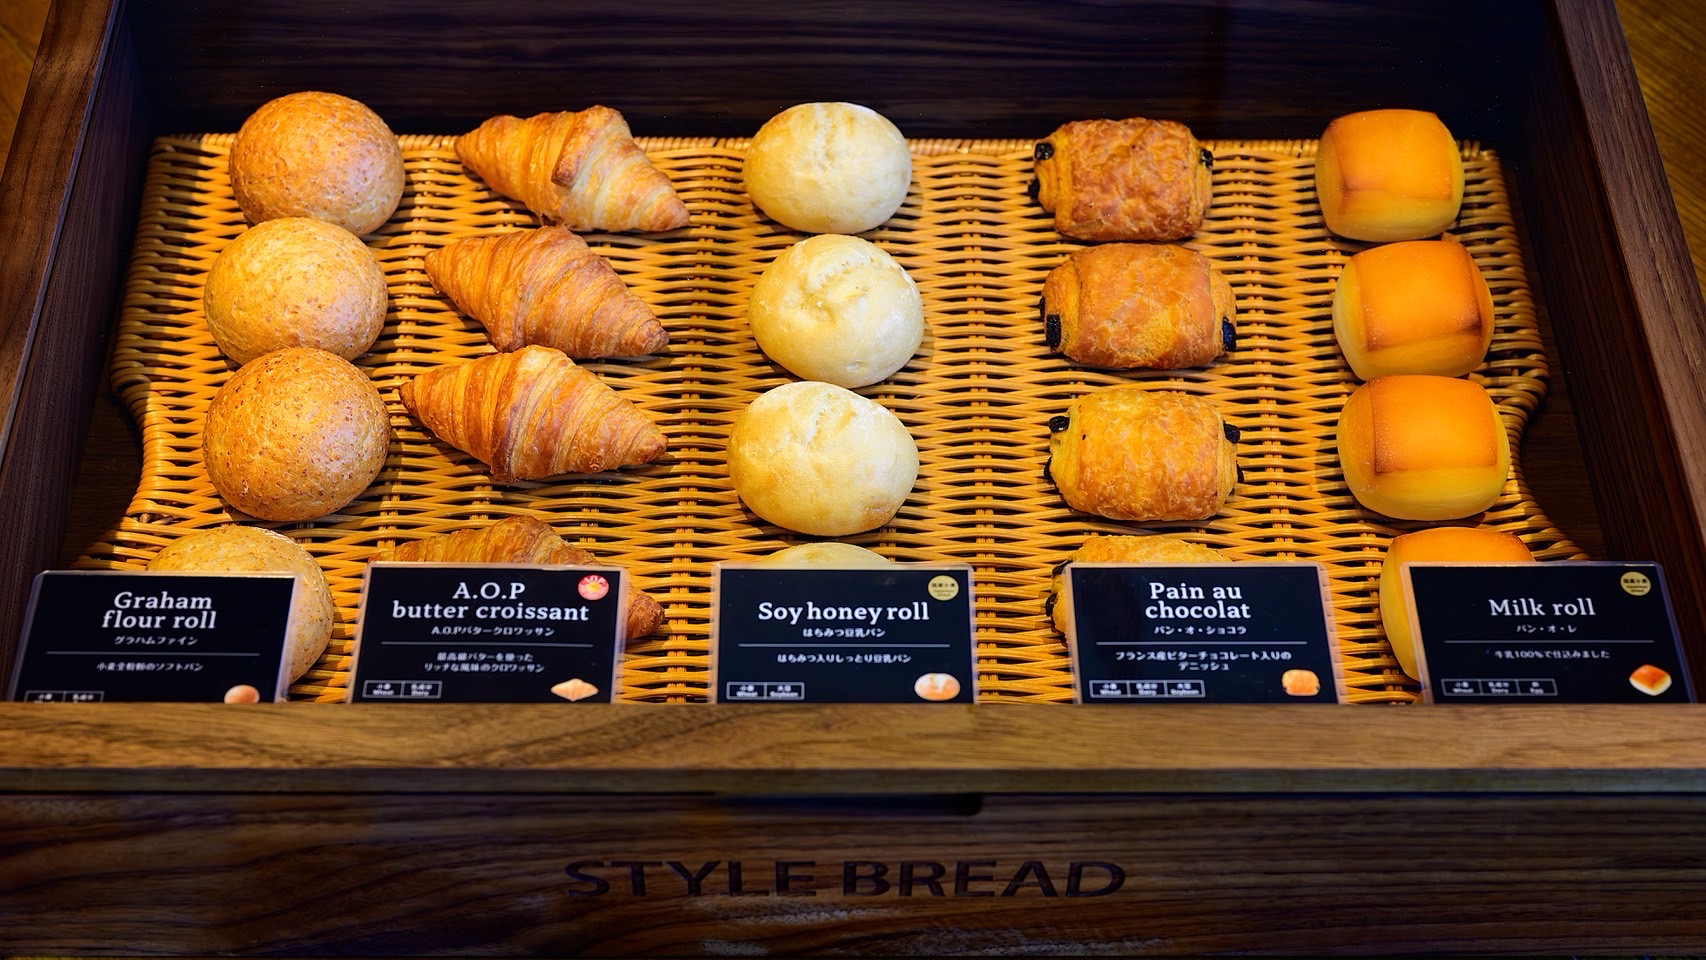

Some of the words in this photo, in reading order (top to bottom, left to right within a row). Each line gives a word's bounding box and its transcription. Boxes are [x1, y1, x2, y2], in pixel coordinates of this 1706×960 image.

[452, 582, 525, 599] A.O.P
[1149, 582, 1205, 600] Pain
[1213, 587, 1242, 600] au
[114, 591, 211, 609] Graham
[1488, 598, 1545, 615] Milk
[1552, 598, 1595, 615] roll
[393, 600, 469, 618] butter
[476, 602, 589, 621] croissant
[758, 602, 803, 625] Soy
[807, 602, 882, 625] honey
[887, 602, 929, 620] roll
[1145, 600, 1251, 618] chocolat
[102, 610, 166, 628] flour
[172, 611, 216, 628] roll
[803, 628, 885, 637] はちみつ豆乳パン
[1154, 626, 1246, 635] パン・オ・ショコラ
[1517, 625, 1576, 633] パン・オ・レ
[115, 636, 197, 645] グラハムファイン
[1178, 662, 1230, 671] デニッシュ
[564, 860, 817, 897] STYLE
[842, 860, 1127, 897] BREAD
